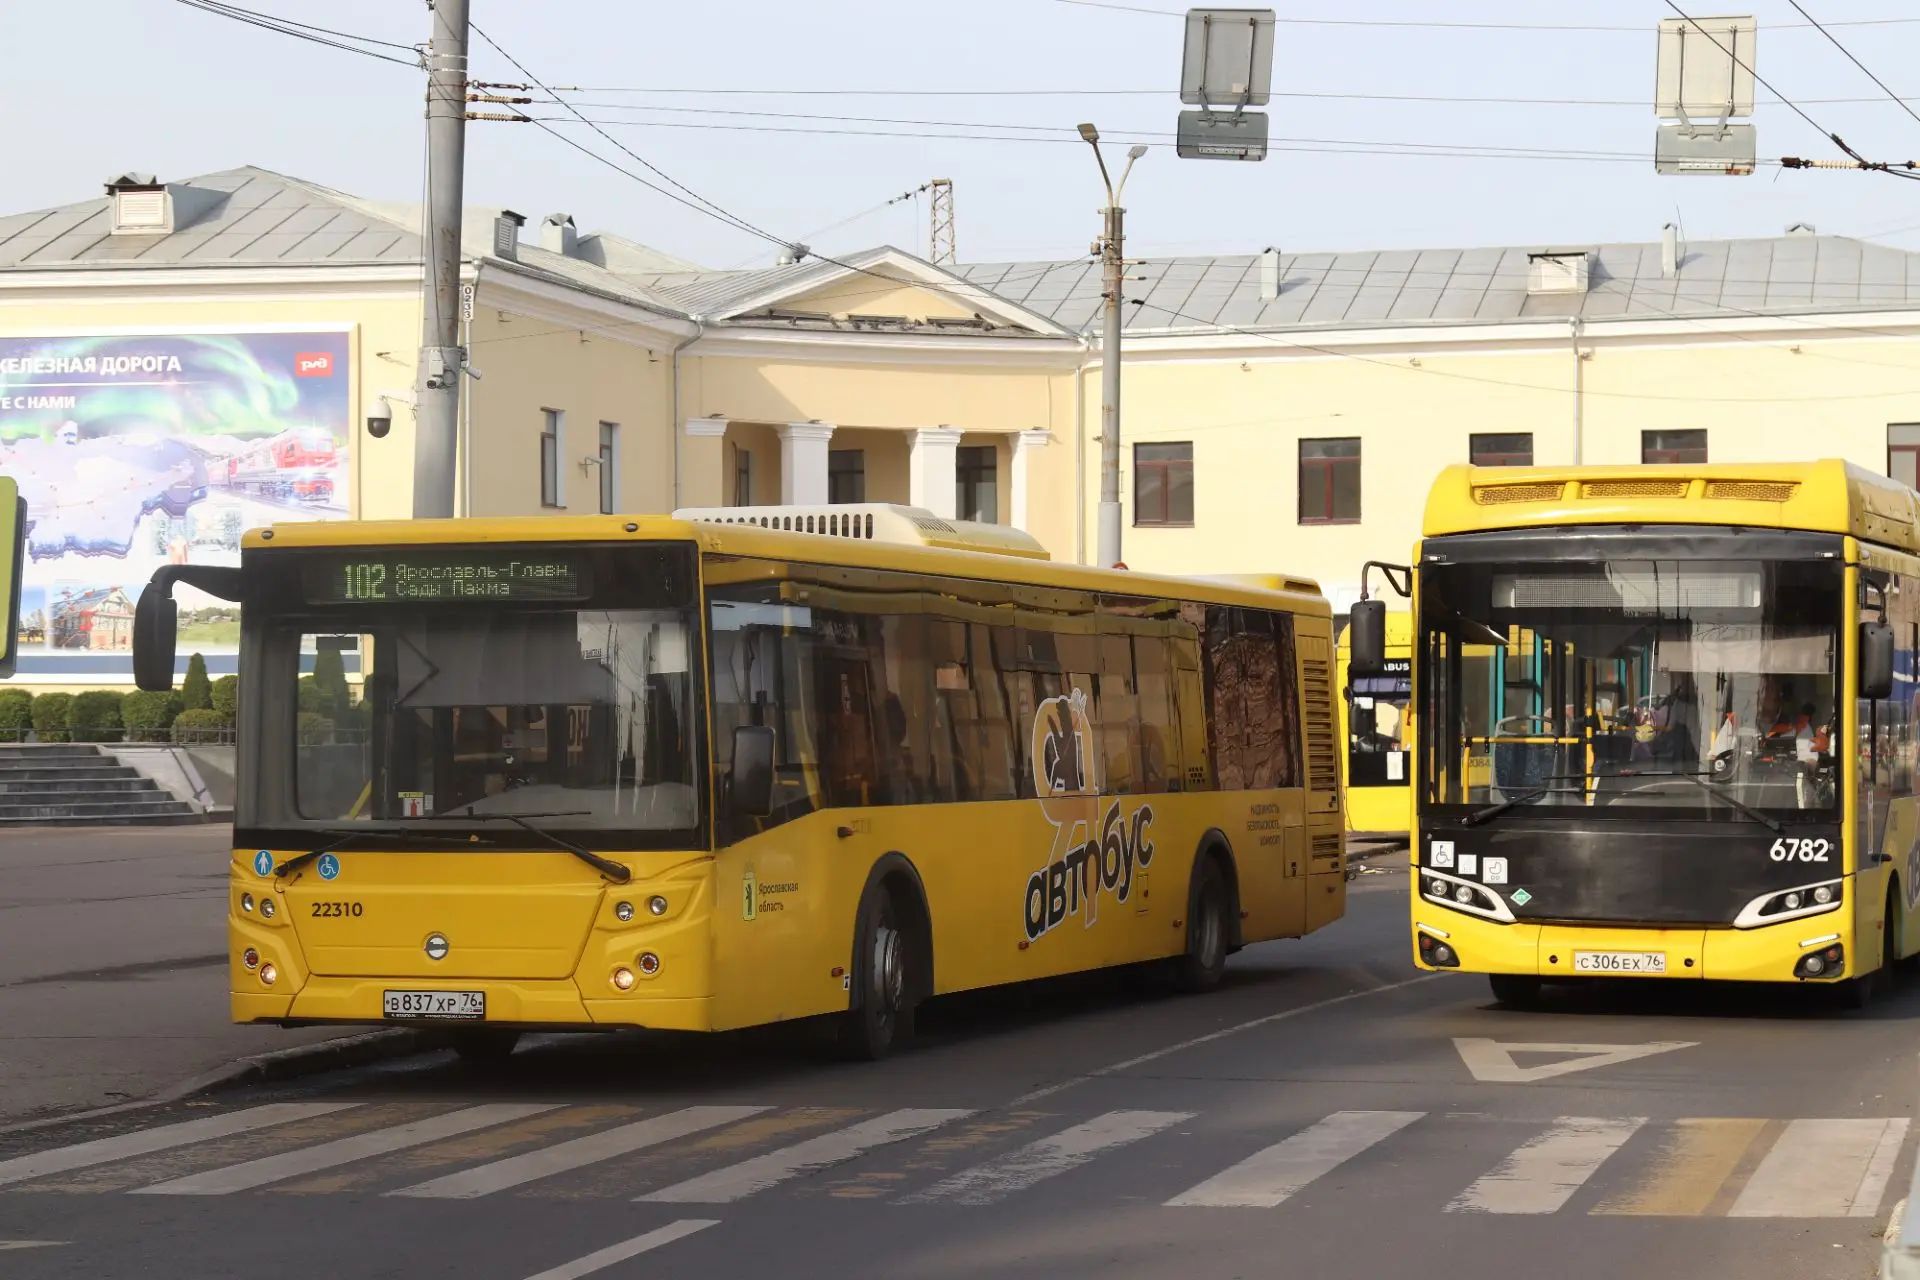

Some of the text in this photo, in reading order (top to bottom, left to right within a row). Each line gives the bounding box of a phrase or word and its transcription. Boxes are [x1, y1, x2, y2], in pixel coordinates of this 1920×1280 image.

[100, 355, 182, 375] ДОРОГА
[14, 397, 25, 409] С
[27, 396, 76, 409] НАМИ
[345, 564, 386, 599] 102
[396, 579, 510, 597] Сады Пахма
[1769, 837, 1829, 863] 6782
[1024, 799, 1154, 943] автобус
[758, 882, 799, 897] Ярославская
[311, 901, 364, 918] 22310
[758, 900, 784, 913] область
[1646, 955, 1661, 967] 76
[462, 993, 478, 1008] 76
